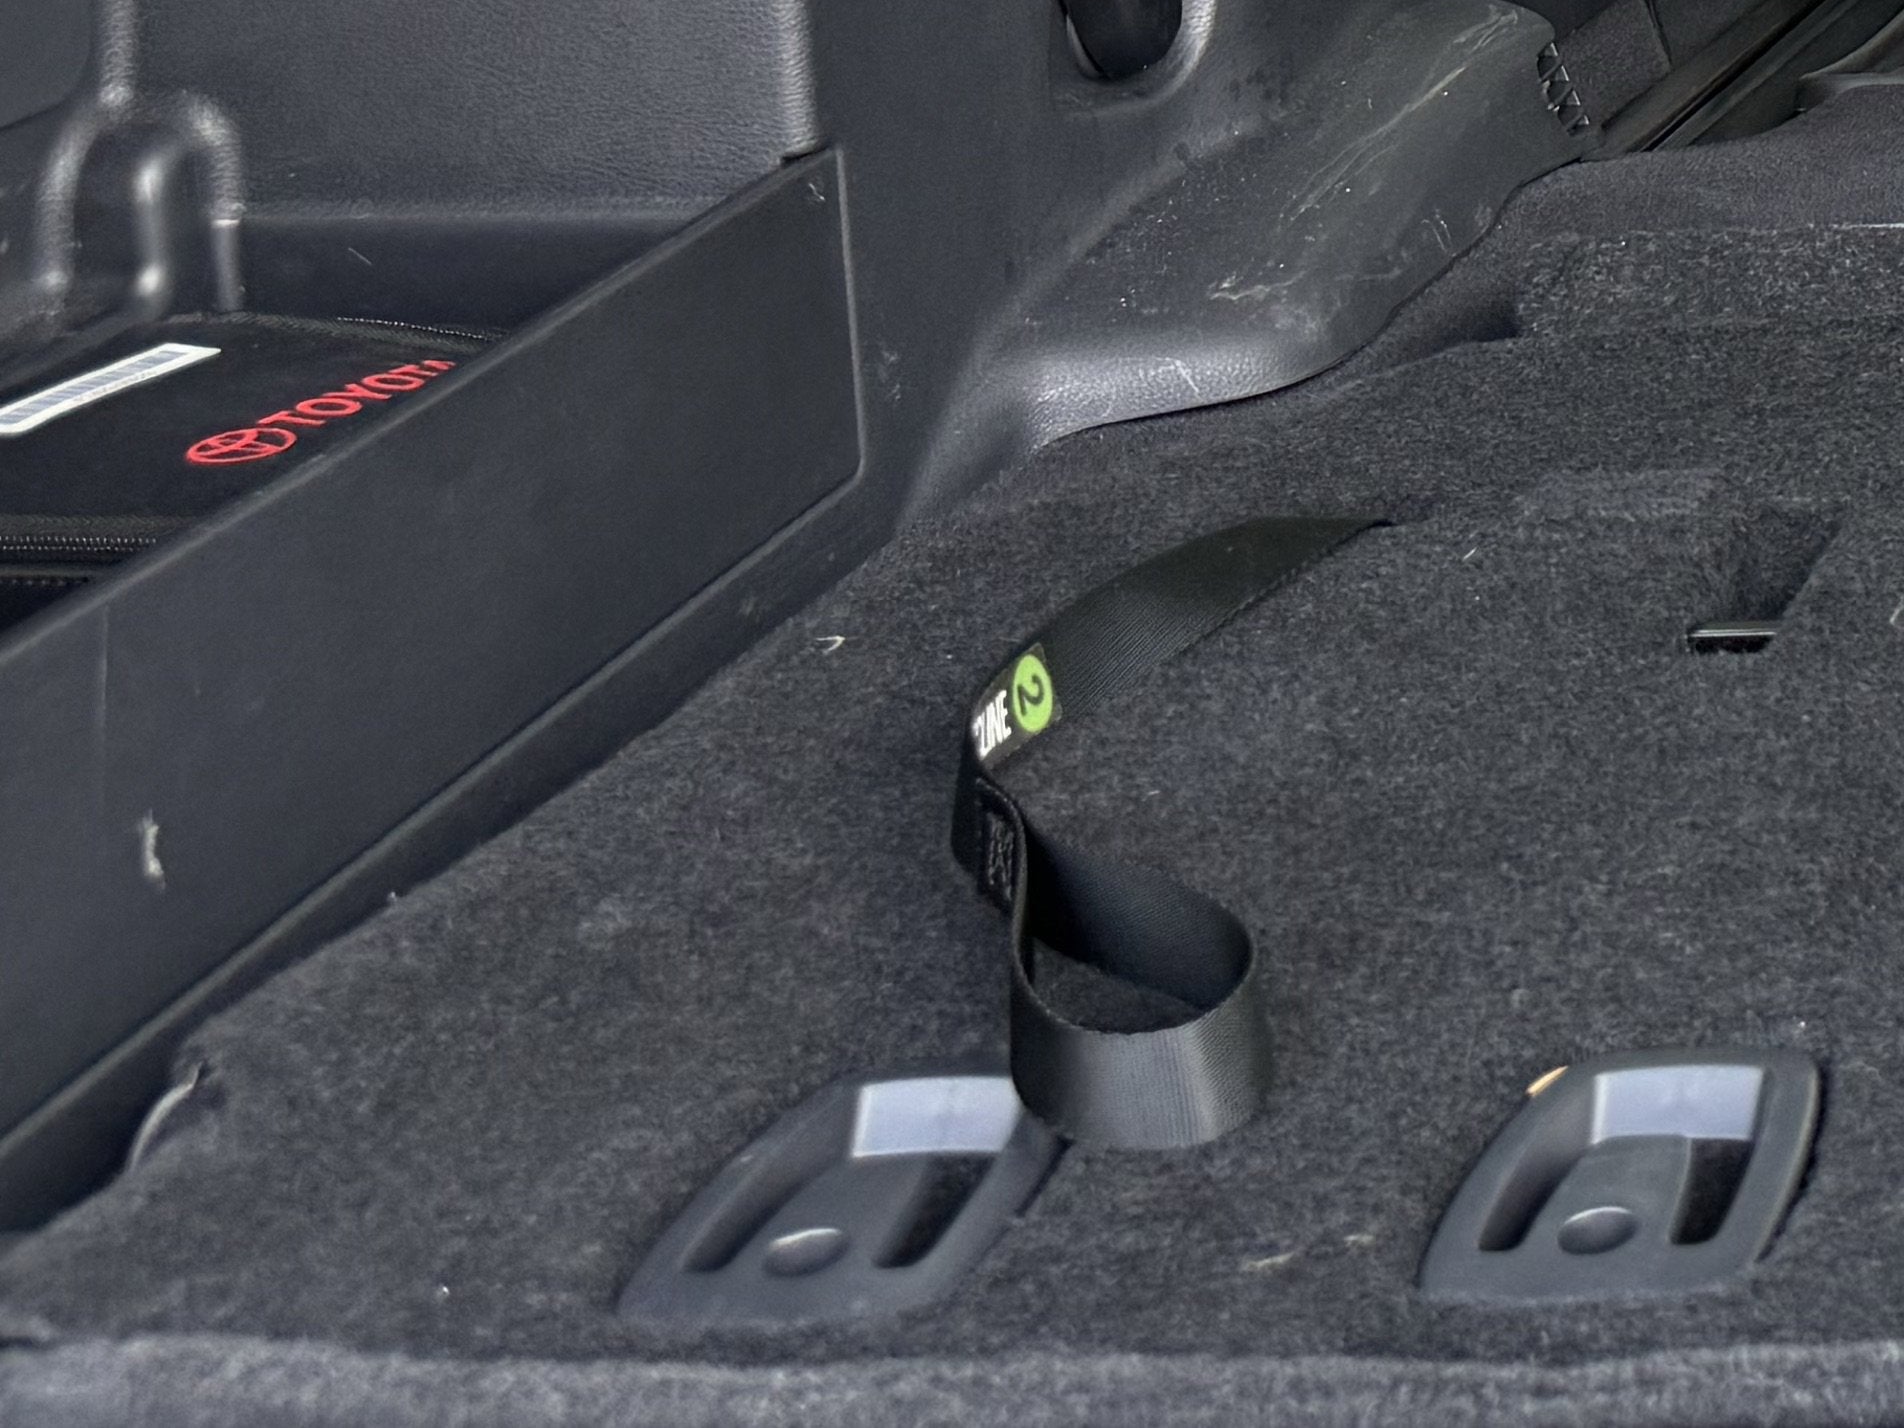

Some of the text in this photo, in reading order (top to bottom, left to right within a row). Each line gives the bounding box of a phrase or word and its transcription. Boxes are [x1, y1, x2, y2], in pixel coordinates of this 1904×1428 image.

[257, 358, 457, 428] TOYOTA
[972, 689, 1012, 757] LINE
[1017, 674, 1045, 716] 2
